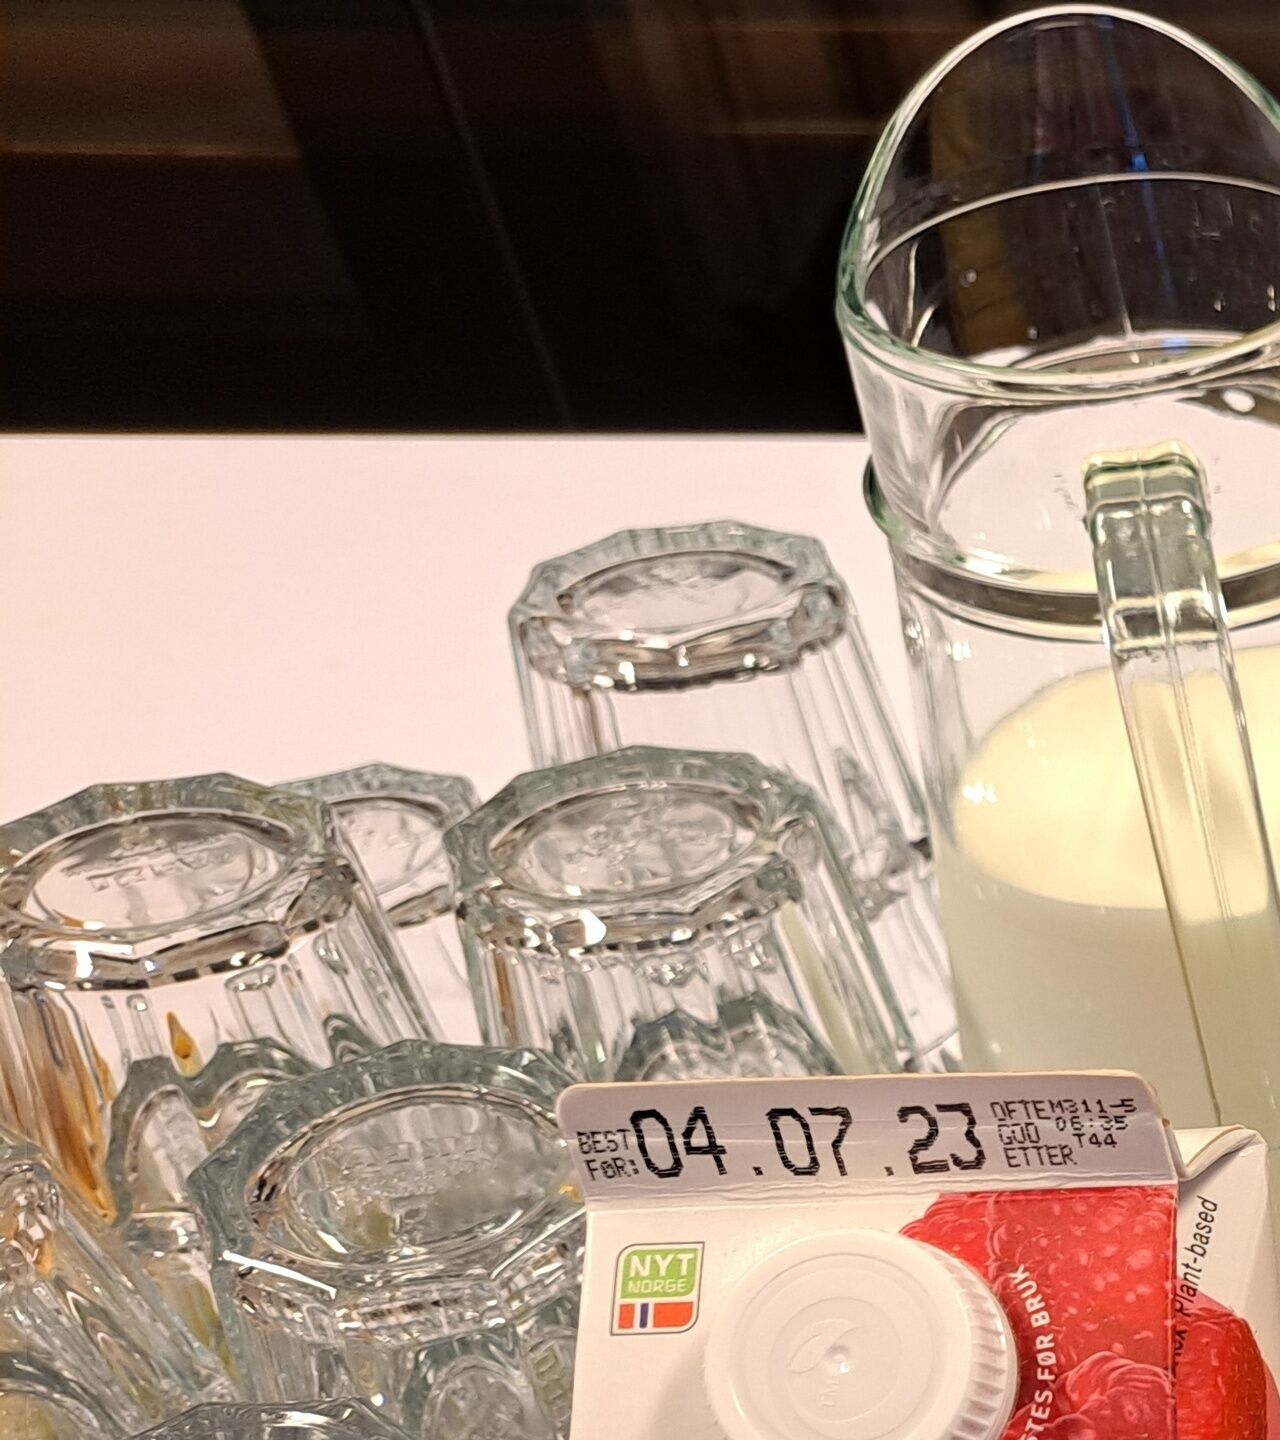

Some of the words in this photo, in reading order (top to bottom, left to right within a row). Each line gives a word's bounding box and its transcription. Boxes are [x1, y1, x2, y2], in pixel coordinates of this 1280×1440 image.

[577, 1128, 630, 1155] BEST
[1003, 1144, 1077, 1168] ETTER
[629, 1254, 694, 1277] NYT
[1174, 1196, 1219, 1317] Plant-based
[627, 1279, 687, 1293] NORGE
[1008, 1264, 1052, 1329] BRUK
